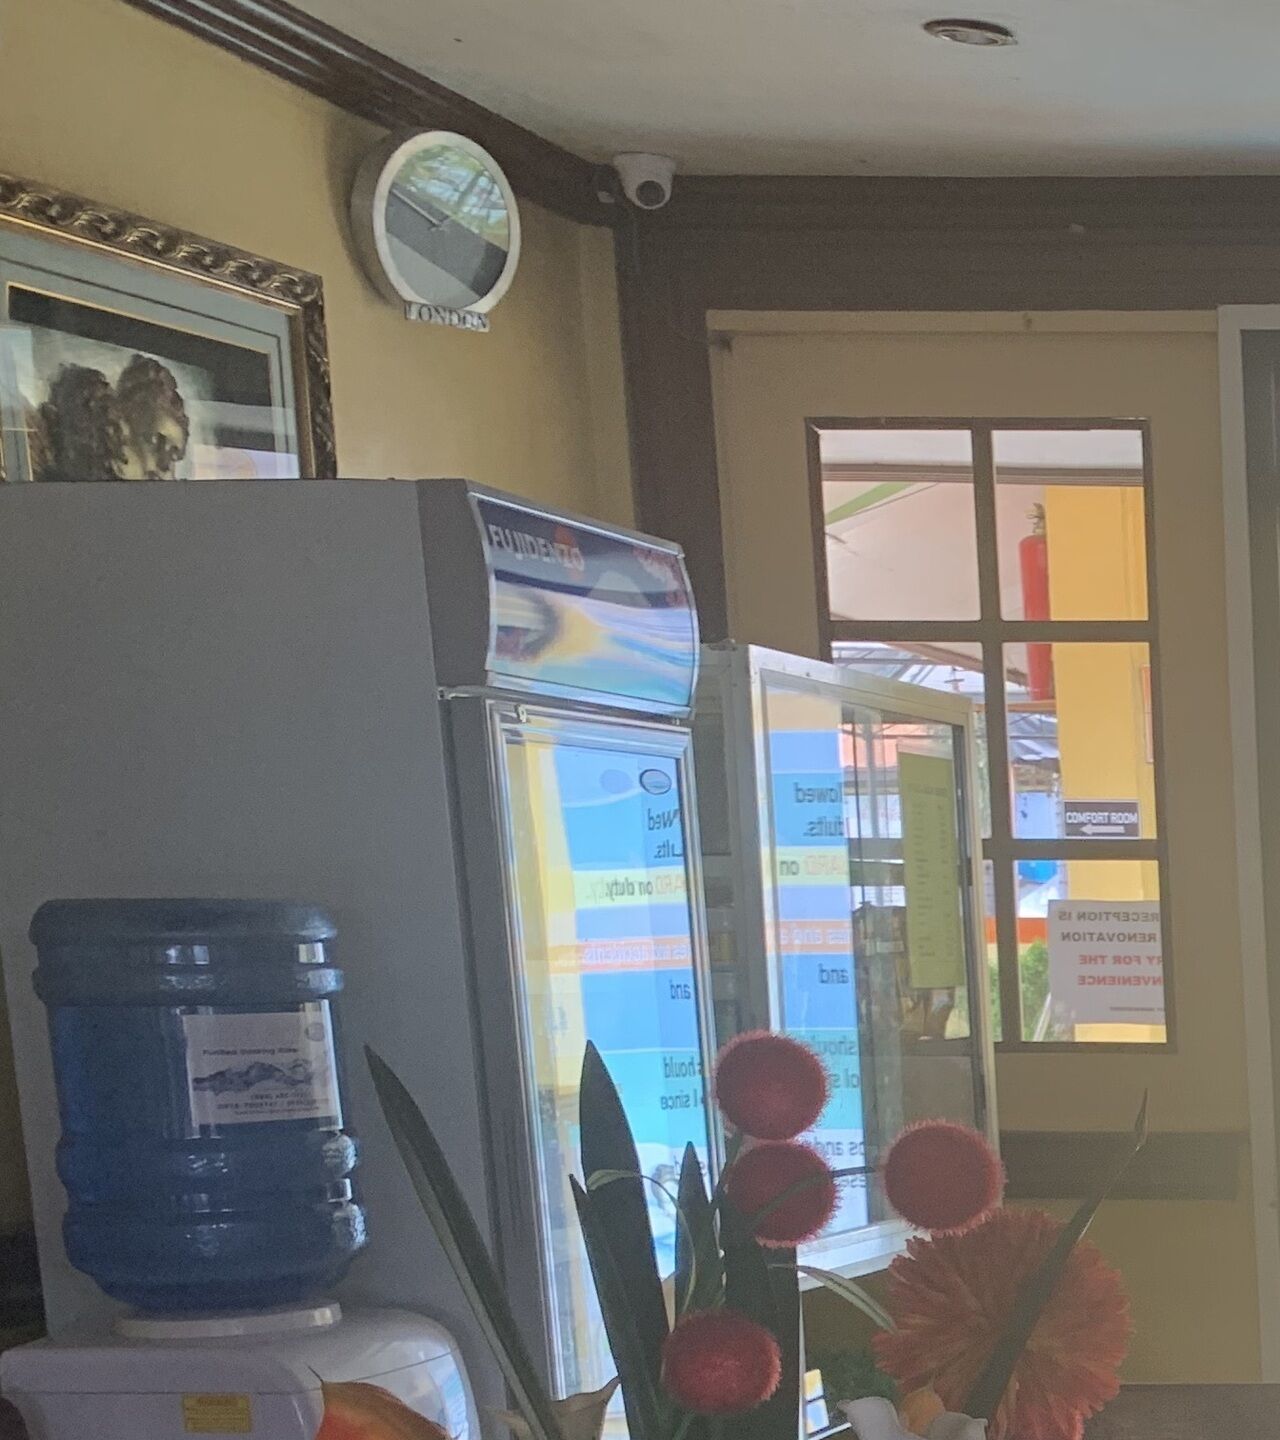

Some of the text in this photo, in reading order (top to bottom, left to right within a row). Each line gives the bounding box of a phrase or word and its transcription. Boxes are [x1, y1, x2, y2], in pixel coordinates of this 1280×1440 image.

[404, 302, 487, 330] LONDON
[488, 524, 585, 571] FUJIDENZO
[1066, 812, 1138, 824] COMFORT ROOM
